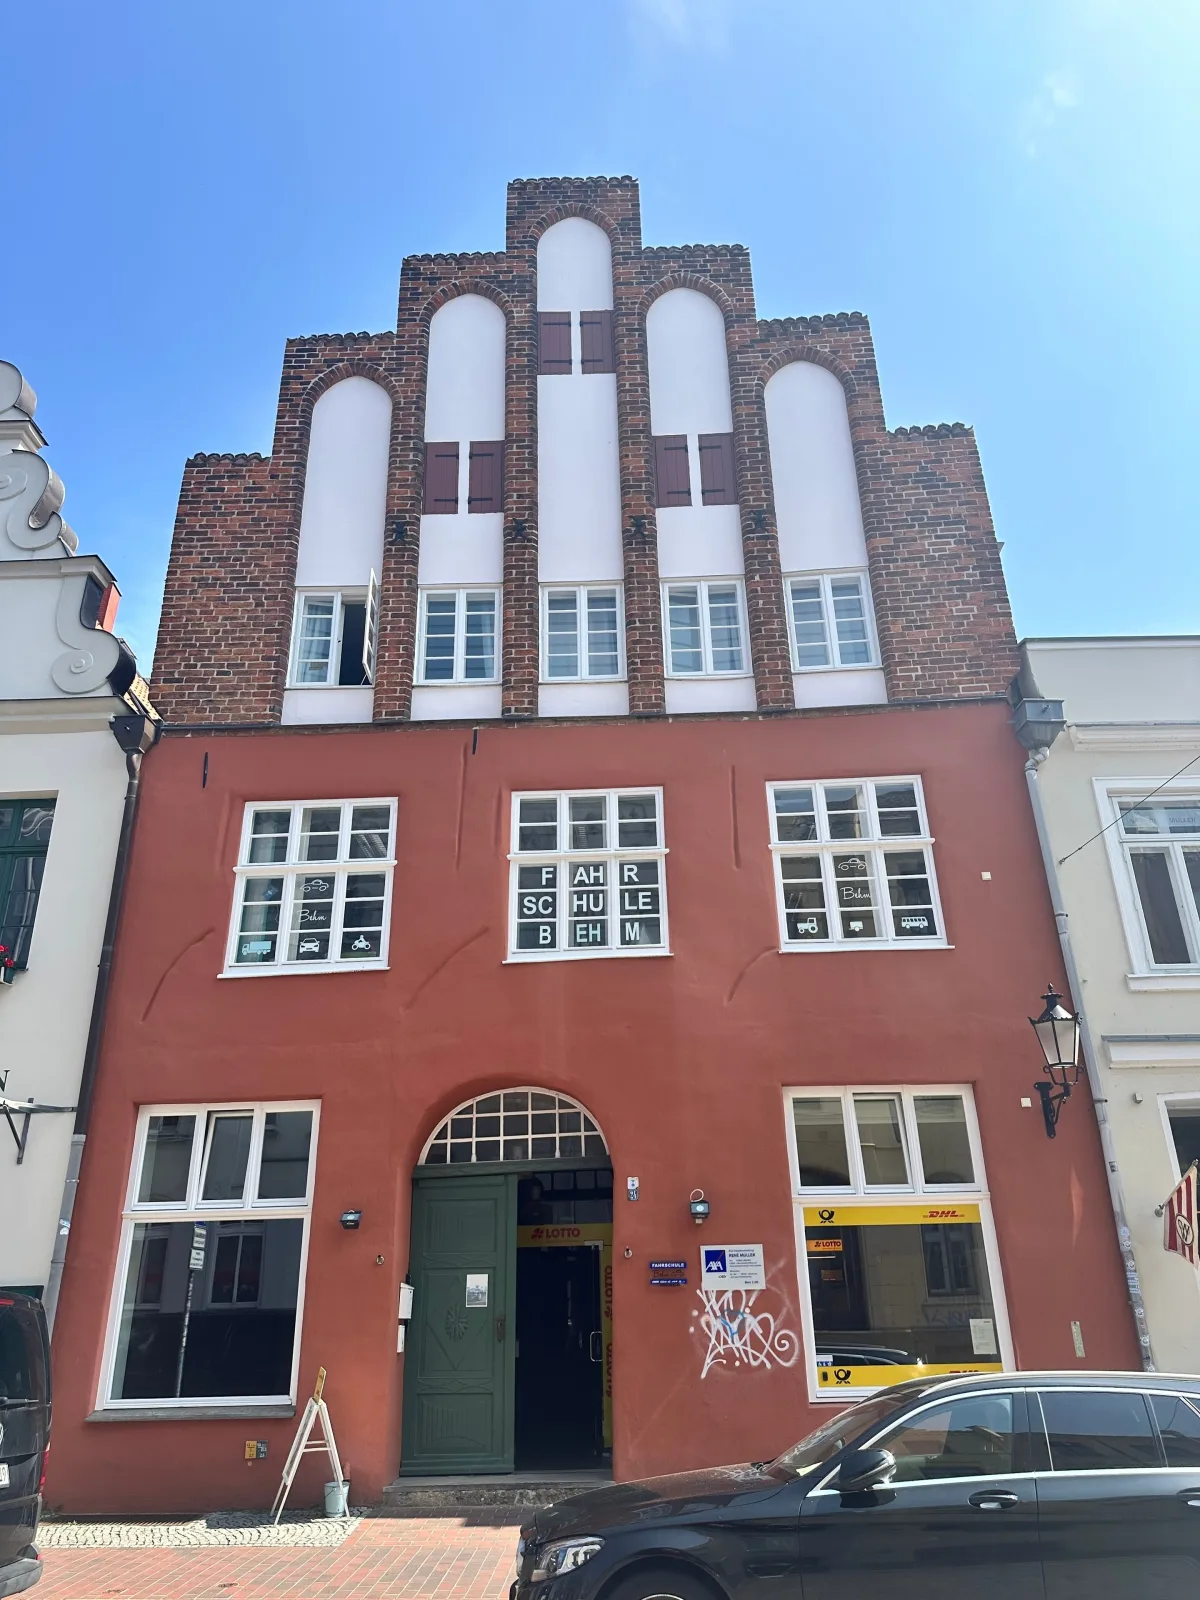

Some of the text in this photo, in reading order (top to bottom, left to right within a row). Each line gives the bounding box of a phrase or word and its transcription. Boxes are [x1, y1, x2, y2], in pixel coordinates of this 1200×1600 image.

[839, 886, 872, 900] Behm
[297, 909, 327, 923] Behm
[928, 1210, 959, 1218] DHL
[545, 1228, 580, 1238] LOTTO
[822, 1240, 842, 1248] LOTTO
[706, 1260, 723, 1271] AXA
